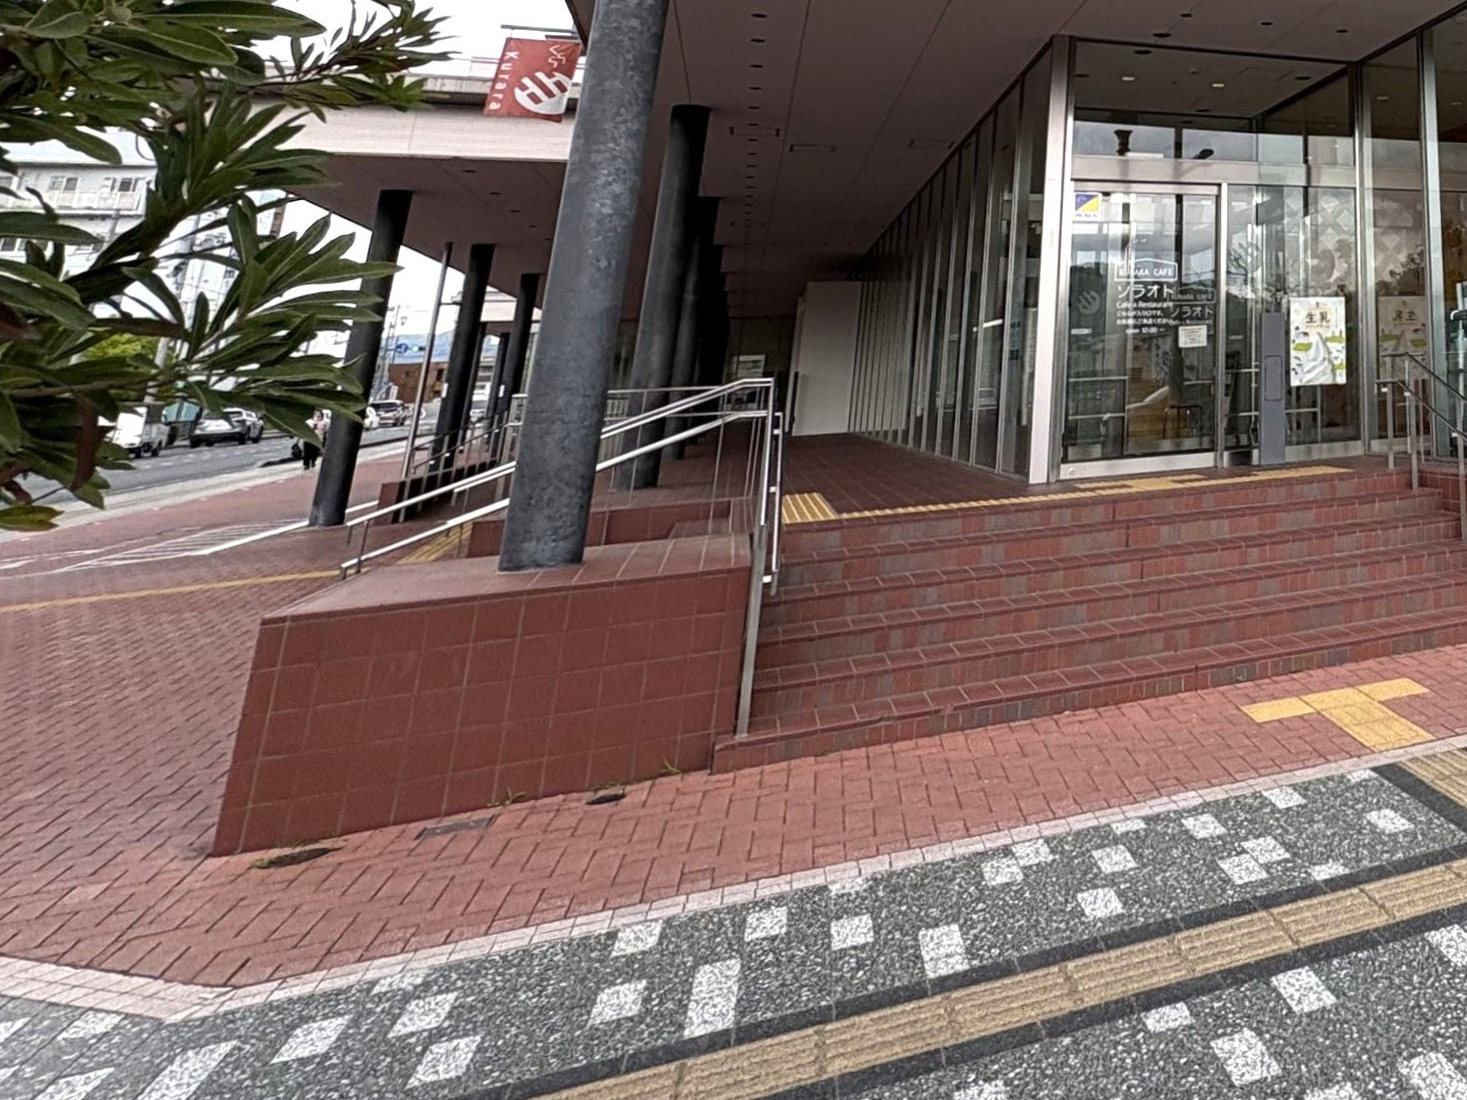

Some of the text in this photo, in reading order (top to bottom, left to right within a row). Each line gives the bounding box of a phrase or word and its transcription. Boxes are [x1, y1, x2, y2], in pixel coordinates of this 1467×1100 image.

[489, 50, 520, 111] Kurara
[1117, 284, 1175, 299] ソラオト
